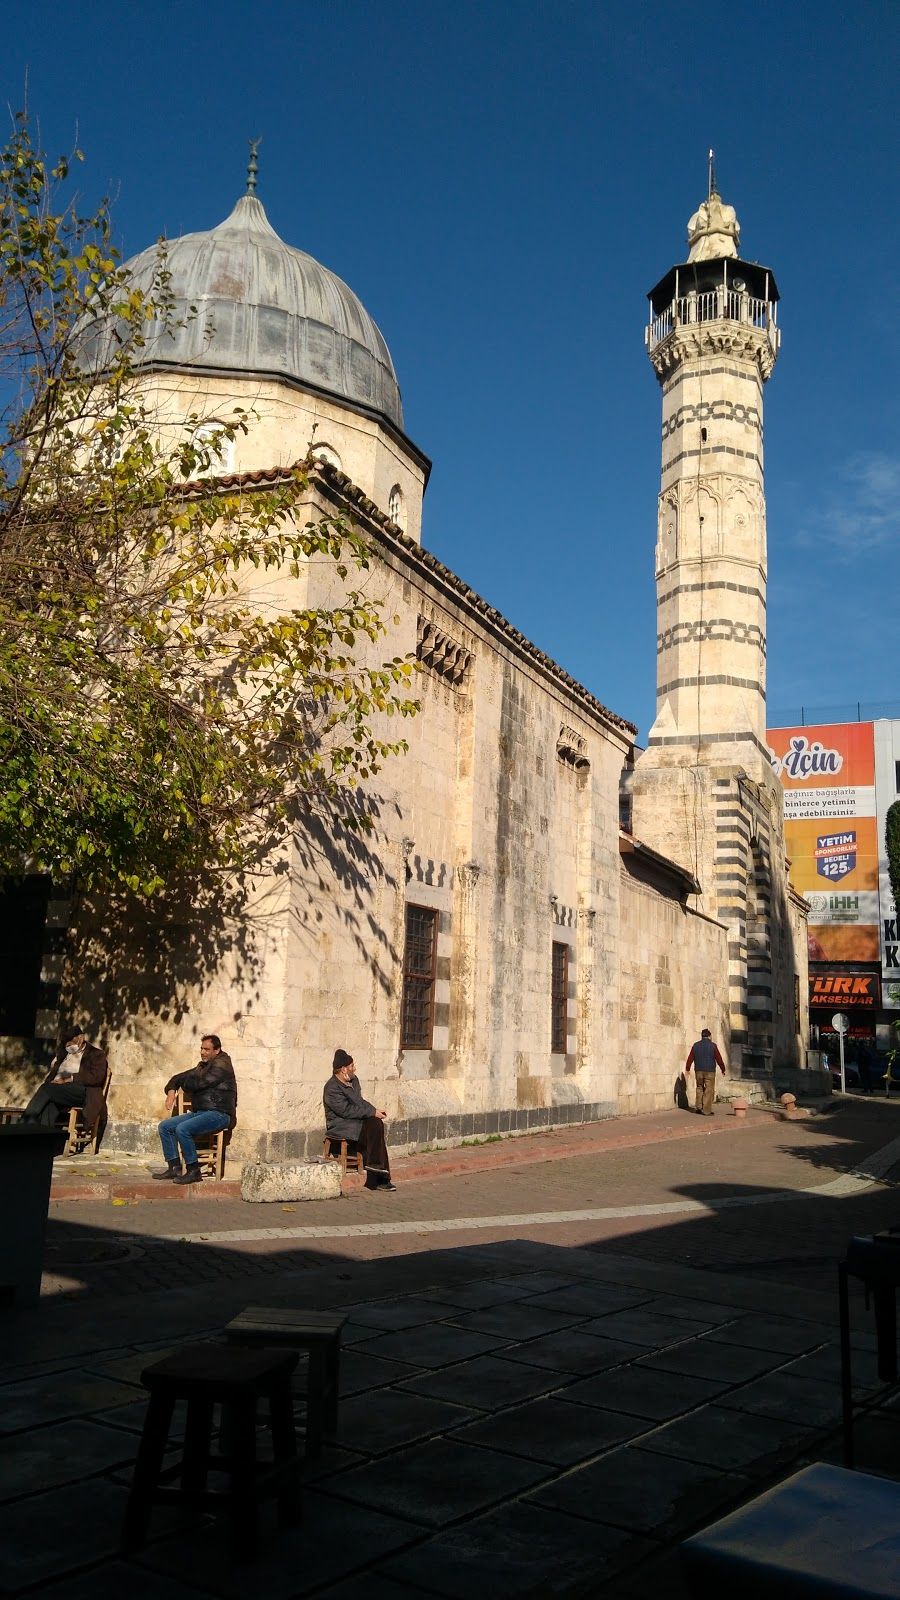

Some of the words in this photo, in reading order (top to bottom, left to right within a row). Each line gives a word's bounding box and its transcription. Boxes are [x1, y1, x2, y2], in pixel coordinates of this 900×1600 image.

[785, 739, 840, 777] İçin
[815, 788, 856, 798] bağışlarla
[785, 800, 820, 808] binlerce
[821, 798, 856, 808] yetimin
[799, 808, 857, 817] edebilirsiniz.
[811, 995, 873, 1005] AKSESUAR
